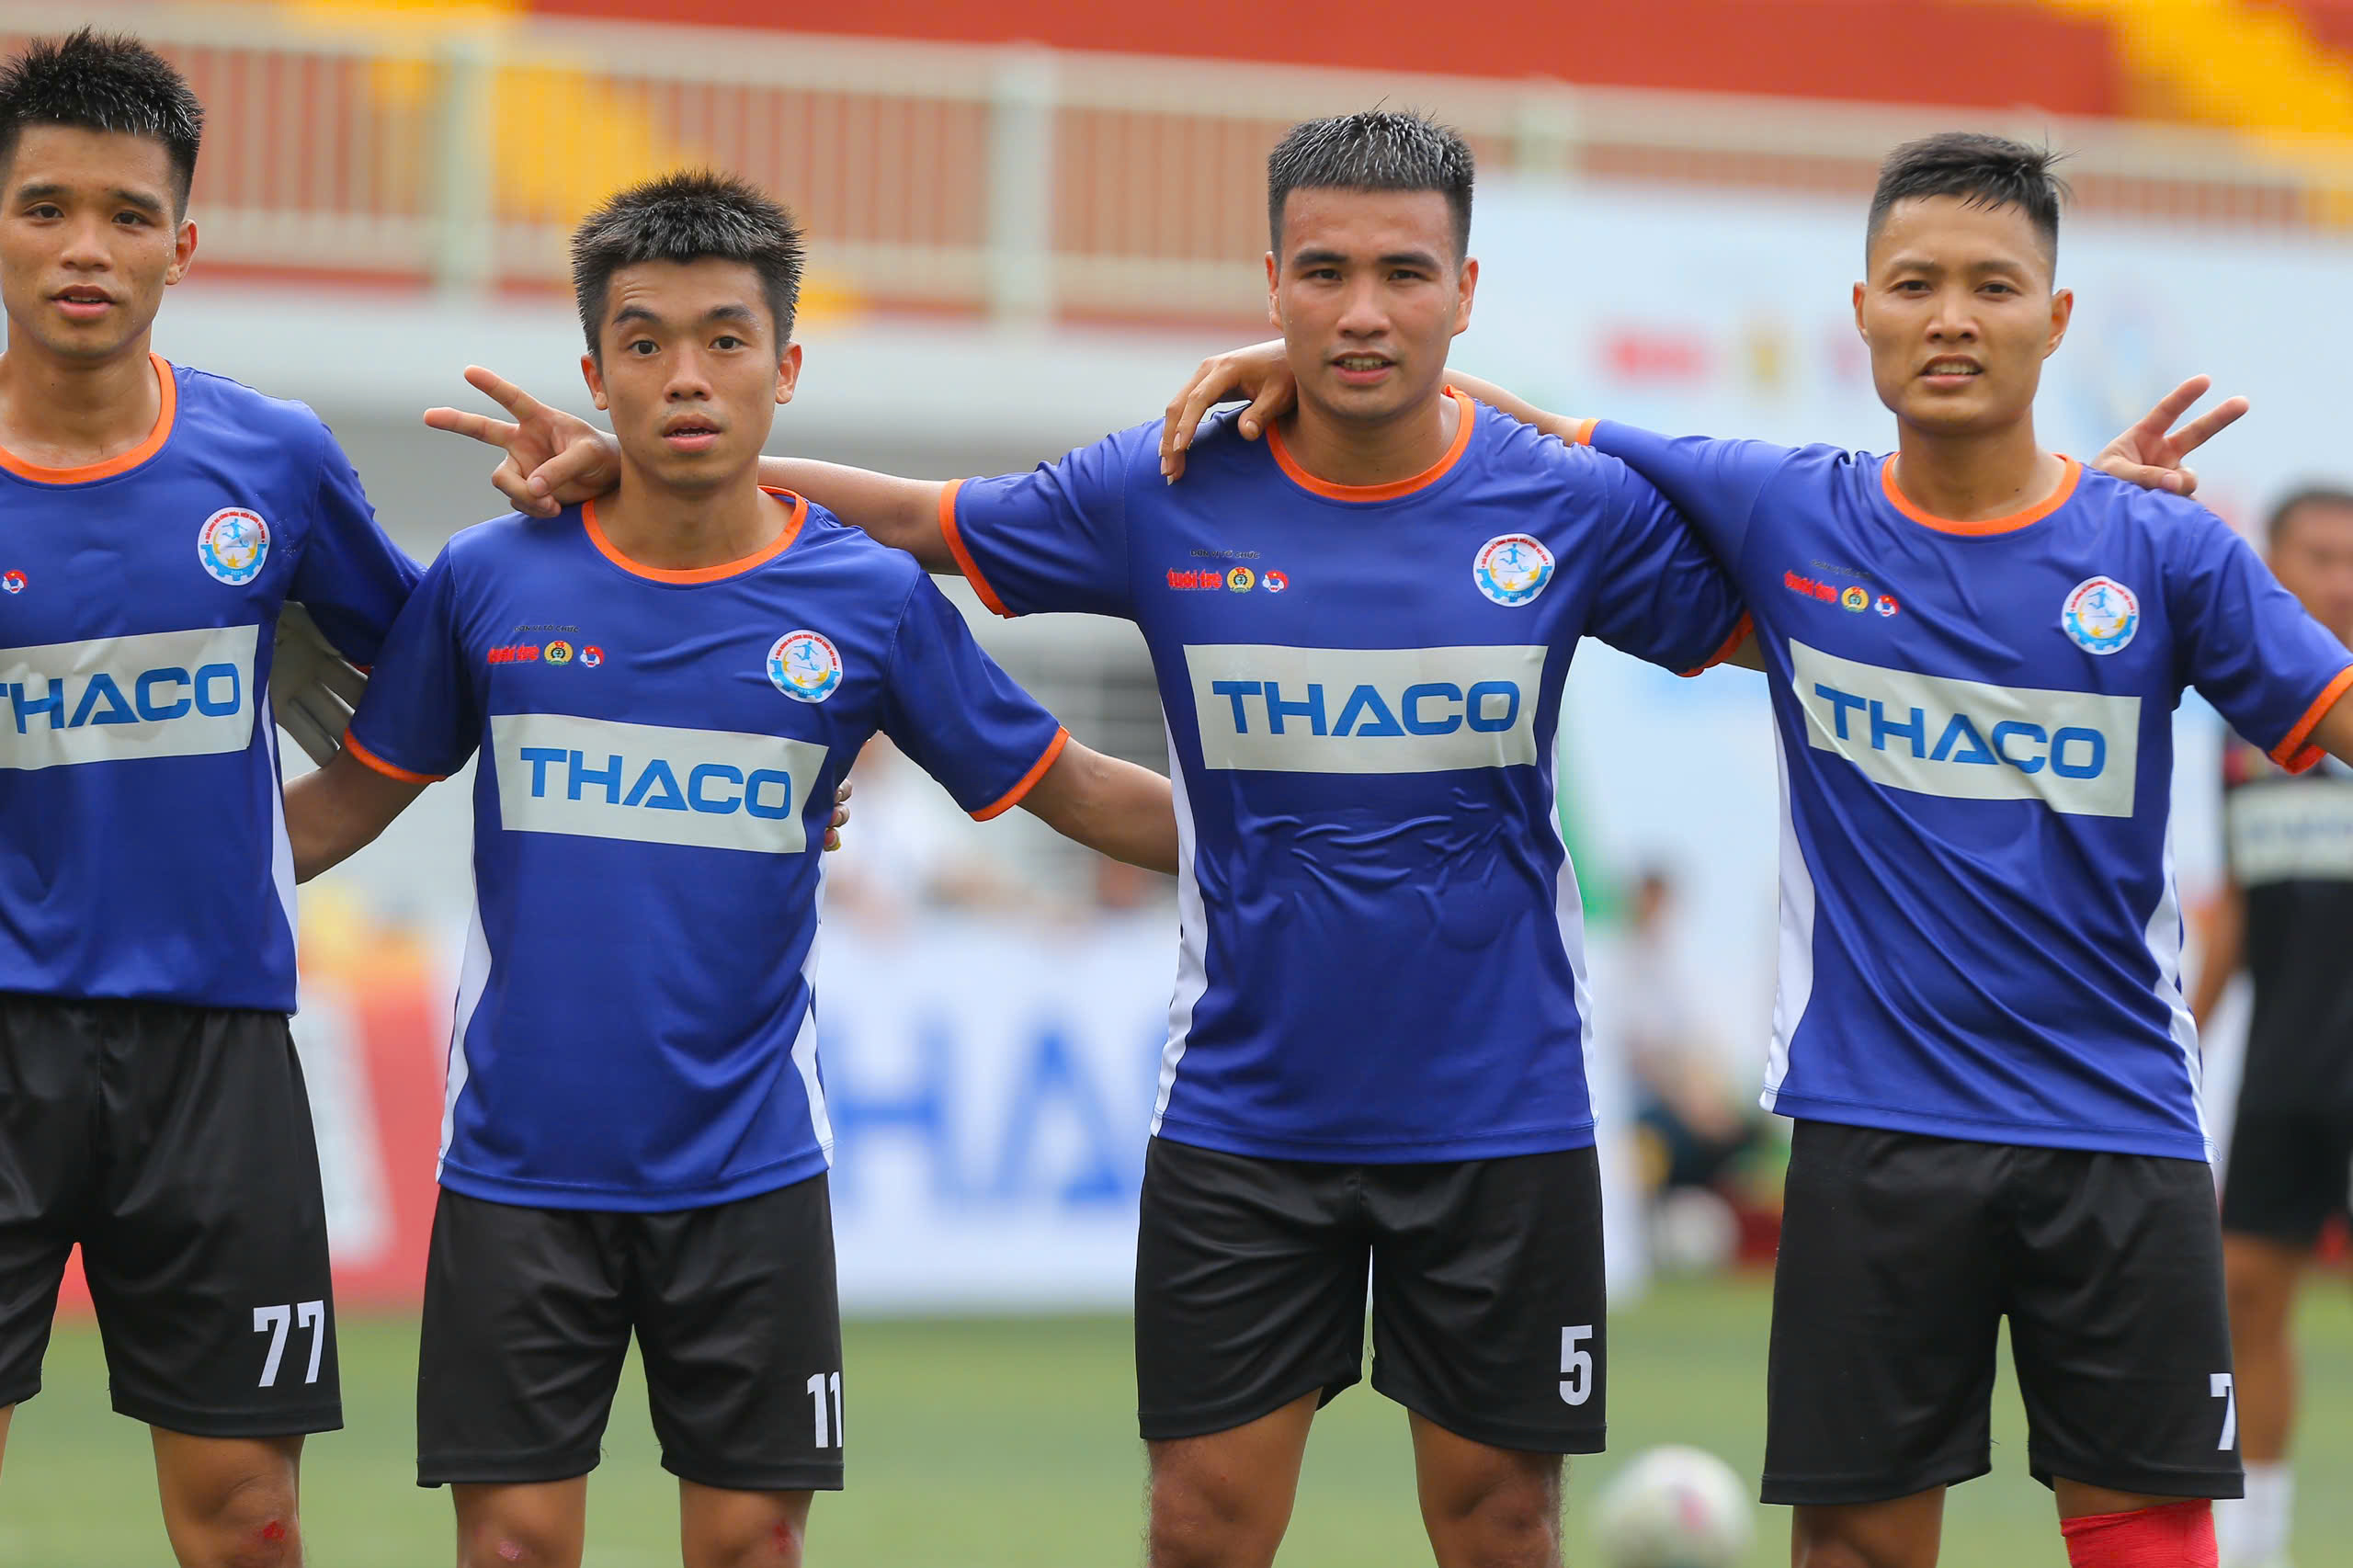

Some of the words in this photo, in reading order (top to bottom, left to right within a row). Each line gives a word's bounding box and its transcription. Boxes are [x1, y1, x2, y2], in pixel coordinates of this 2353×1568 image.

[0, 663, 241, 733] HACO
[1212, 681, 1519, 736] THACO
[1814, 682, 2106, 778] THACO
[520, 748, 791, 820] THACO
[254, 1300, 324, 1387] 77
[1560, 1324, 1593, 1405] 5
[807, 1371, 843, 1448] 11
[2210, 1373, 2236, 1450] 7
